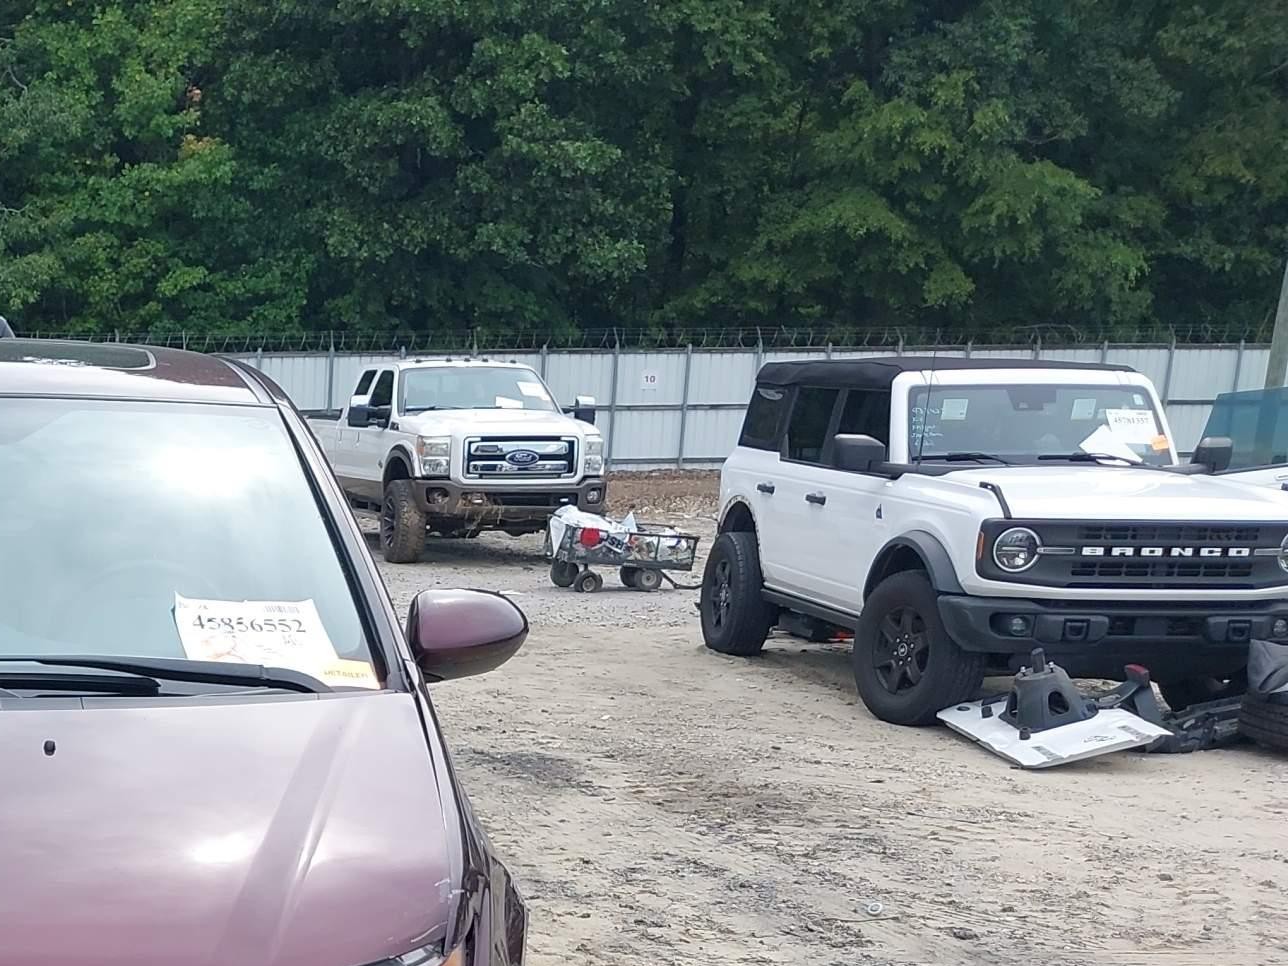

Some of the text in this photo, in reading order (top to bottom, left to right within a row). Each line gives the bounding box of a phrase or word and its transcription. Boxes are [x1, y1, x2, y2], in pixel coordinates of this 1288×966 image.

[644, 375, 656, 383] 10
[1081, 546, 1250, 557] BRONCO
[192, 614, 306, 633] 45856552
